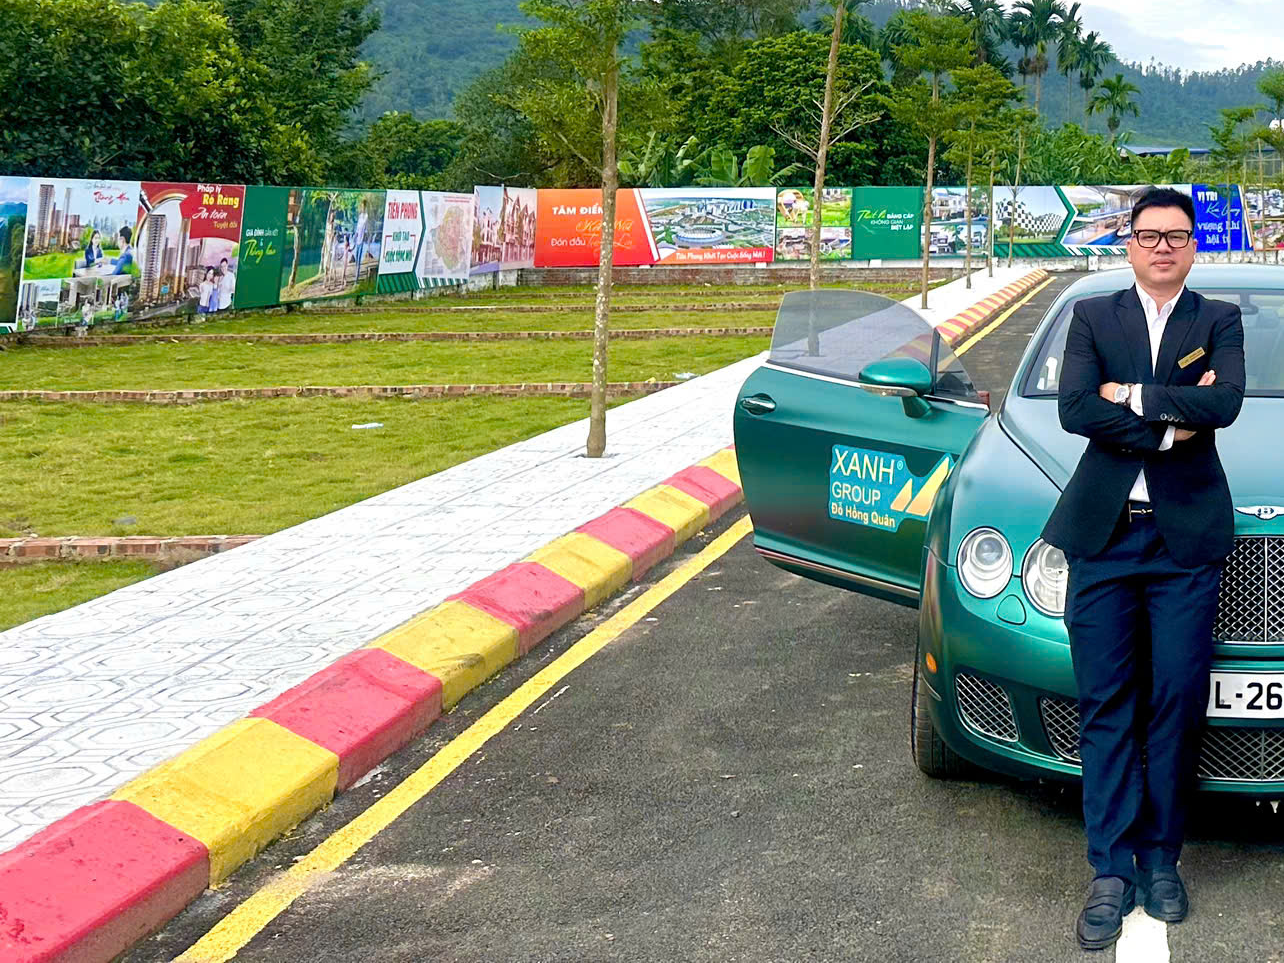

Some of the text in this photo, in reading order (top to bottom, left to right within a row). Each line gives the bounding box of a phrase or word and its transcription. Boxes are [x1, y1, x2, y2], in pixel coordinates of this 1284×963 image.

[552, 204, 577, 216] TÂM
[550, 238, 568, 247] Đón
[832, 448, 895, 485] XANH
[831, 481, 881, 507] GROUP
[845, 506, 869, 525] Hồng
[871, 511, 896, 528] Quân
